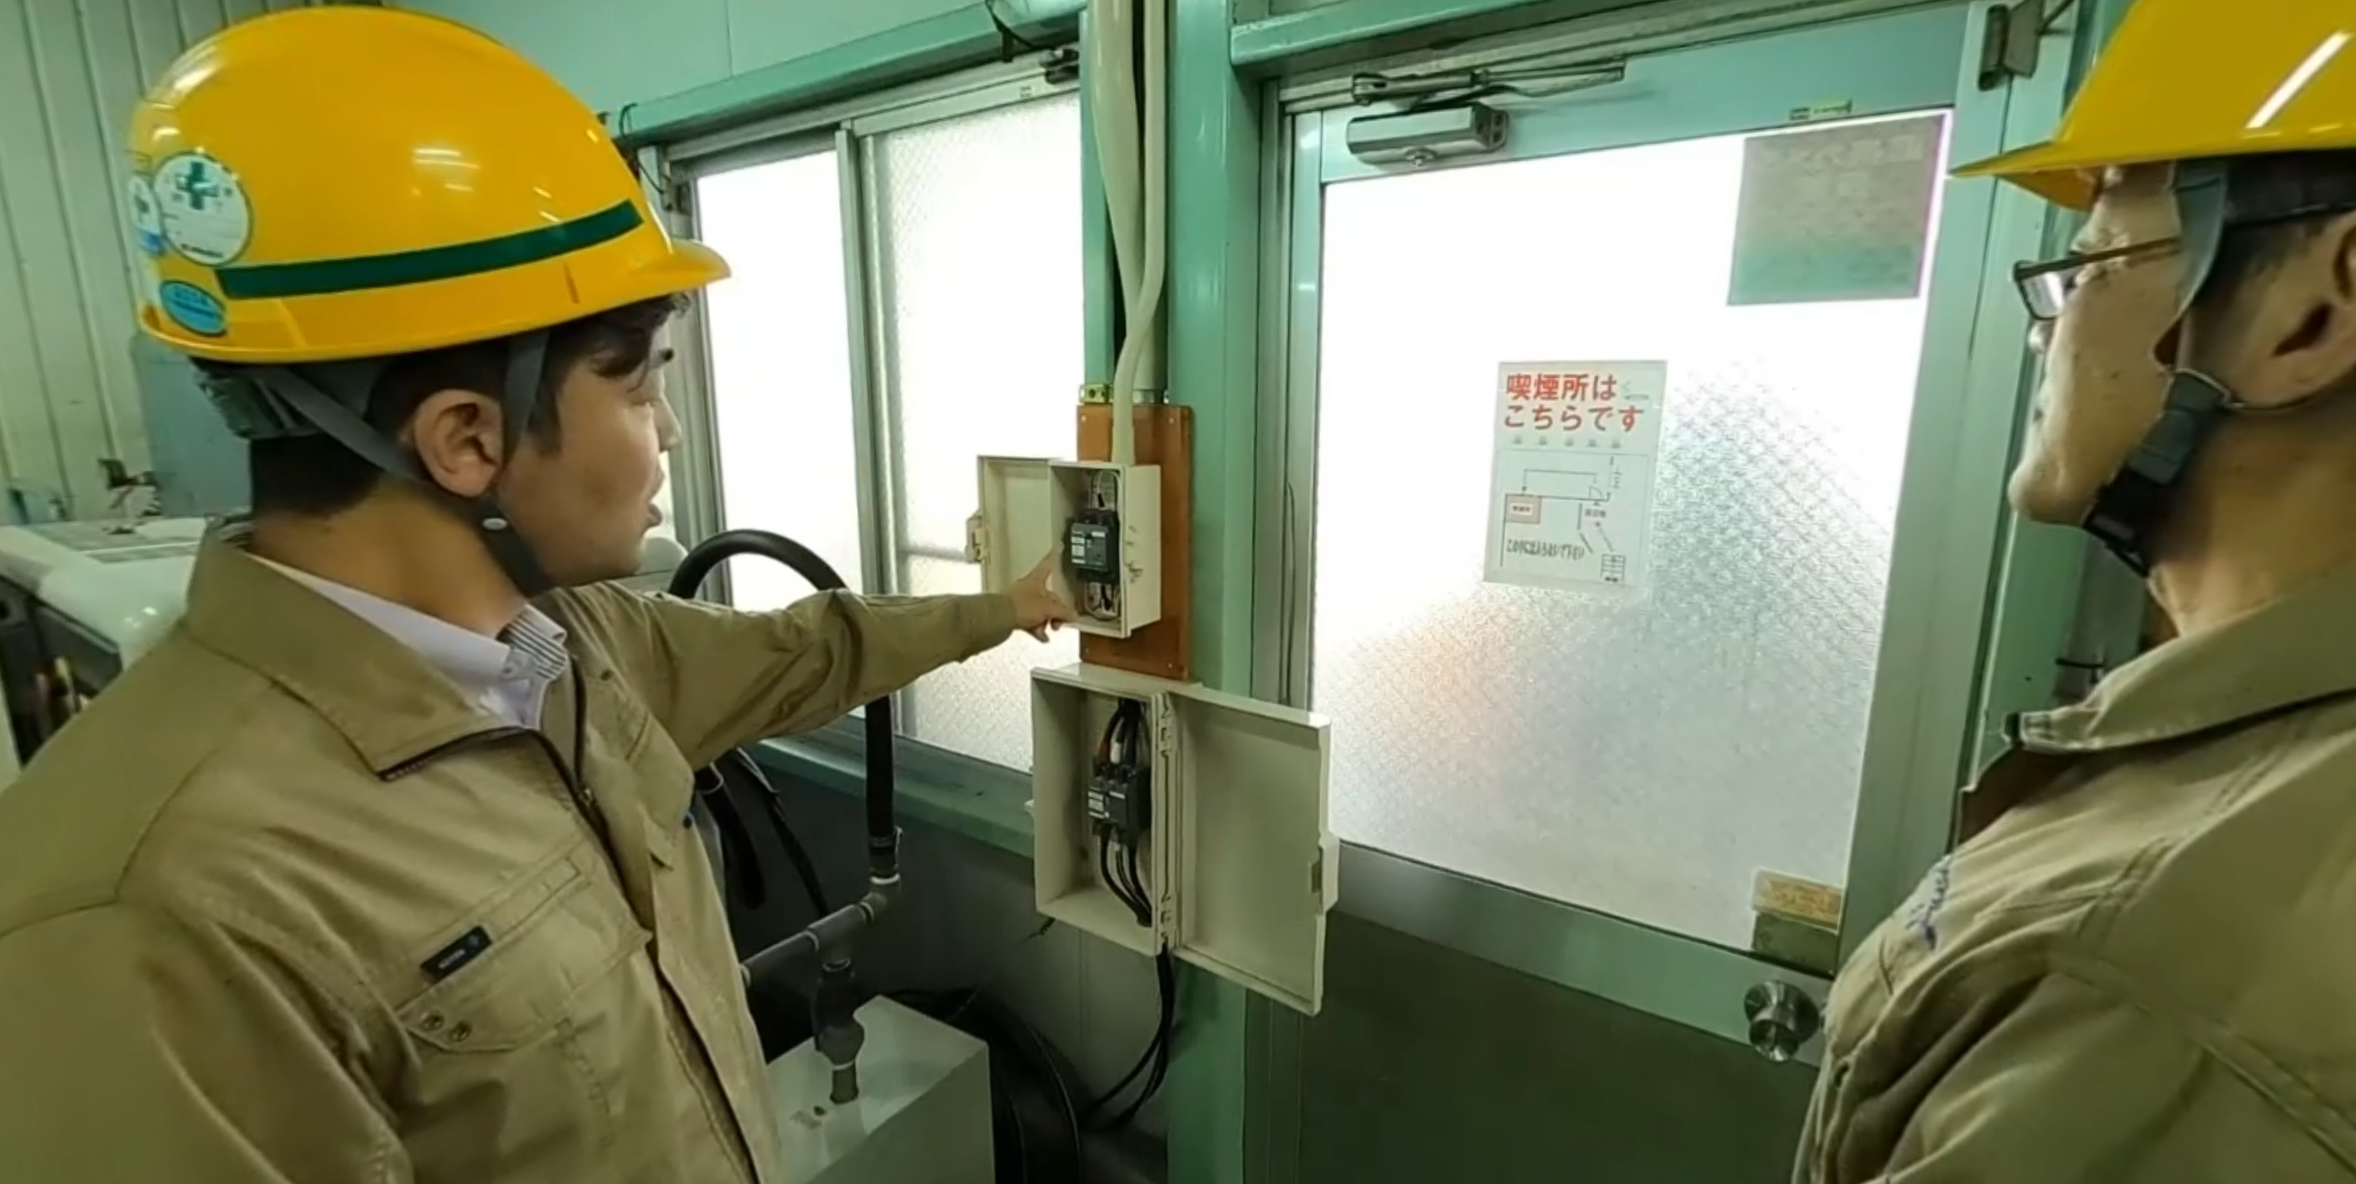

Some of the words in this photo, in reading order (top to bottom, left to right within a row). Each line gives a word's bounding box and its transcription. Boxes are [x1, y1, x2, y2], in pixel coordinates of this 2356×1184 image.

[1506, 373, 1617, 401] 喫煙所は
[1504, 404, 1644, 432] こちらです
